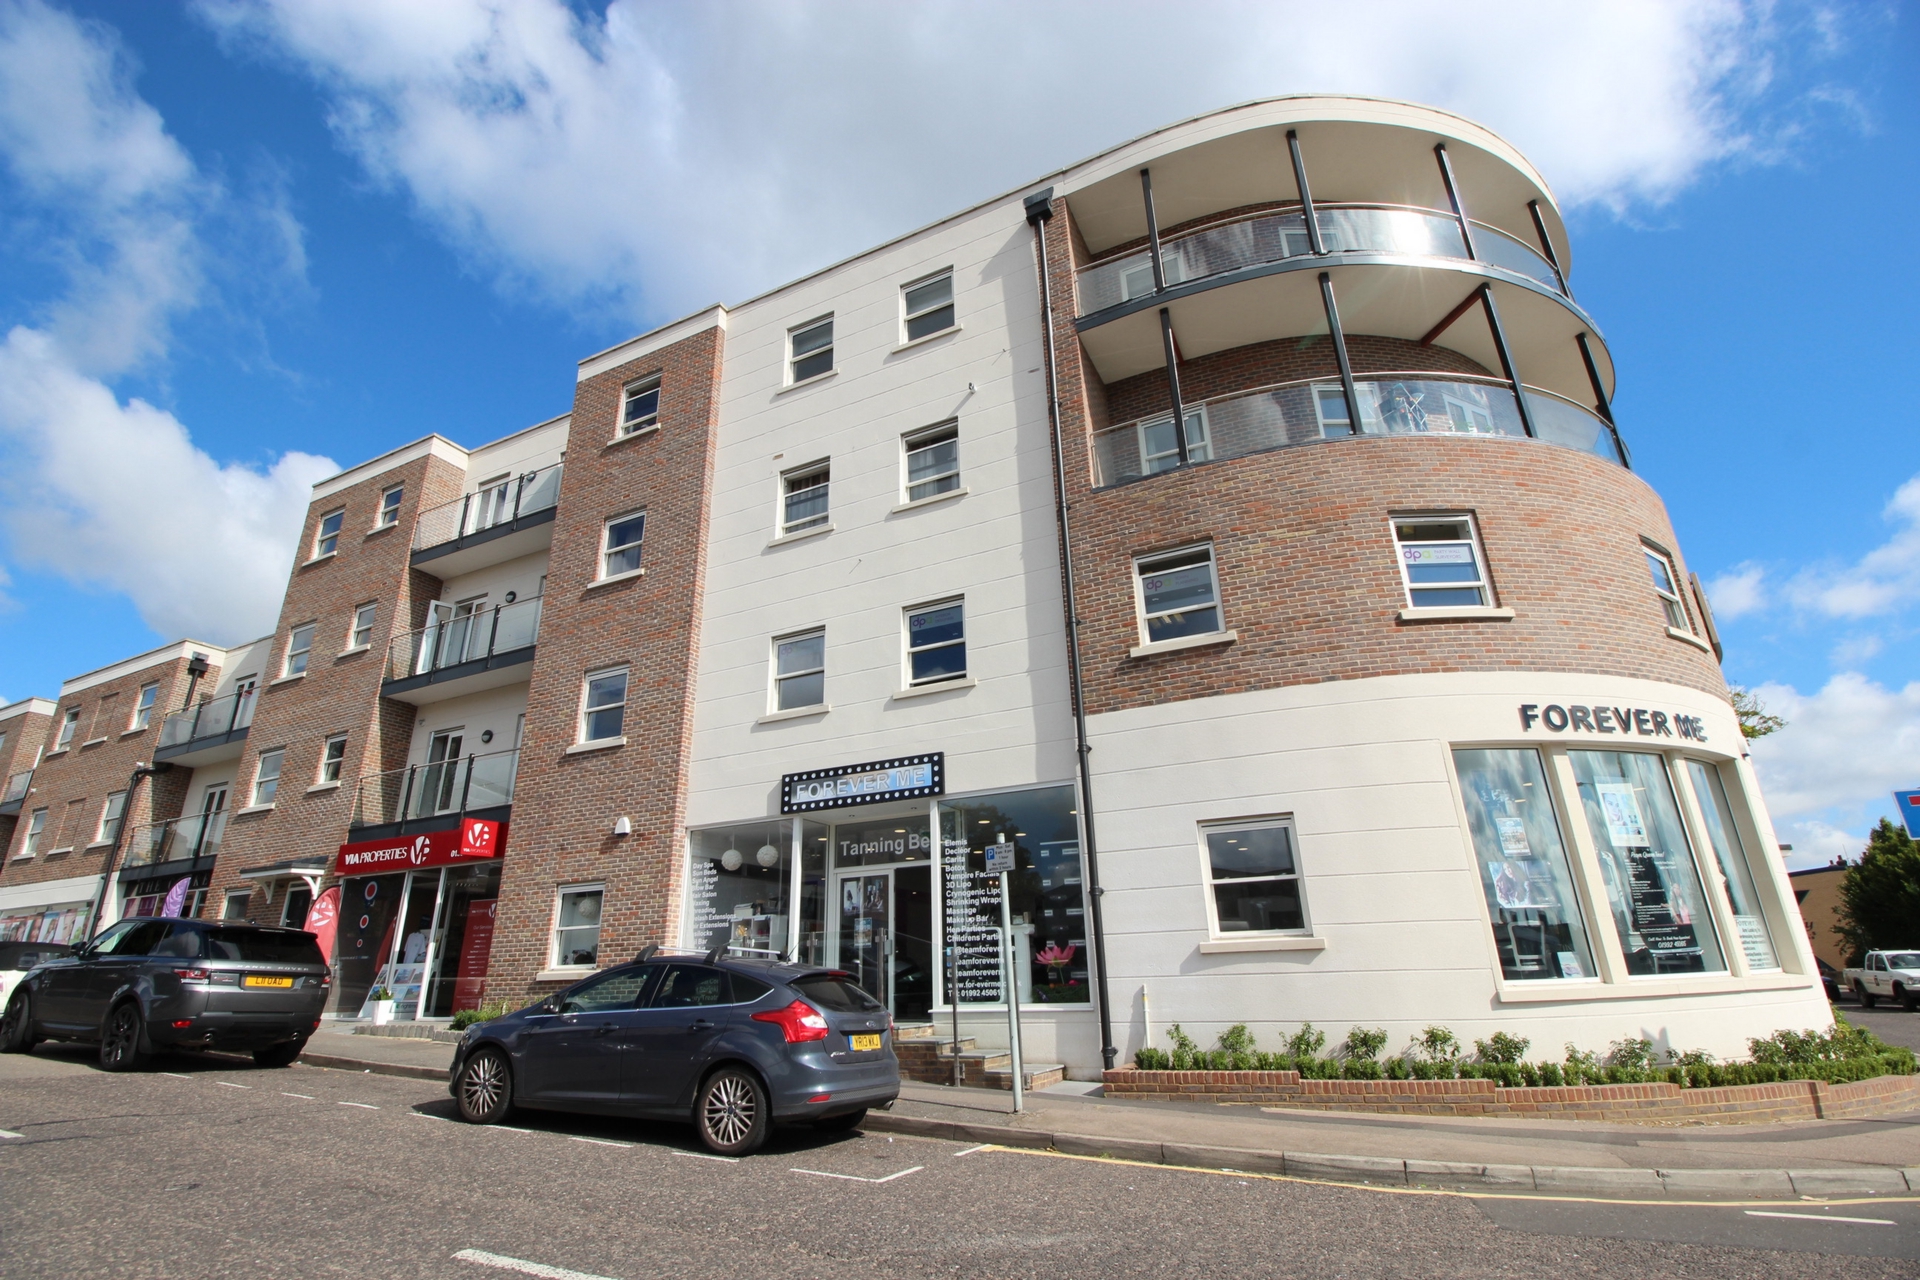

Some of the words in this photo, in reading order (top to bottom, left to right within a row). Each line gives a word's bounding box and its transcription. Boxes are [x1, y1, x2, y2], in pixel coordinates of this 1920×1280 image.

[1404, 548, 1432, 562] dpa
[1146, 577, 1173, 591] dpa
[1518, 704, 1672, 738] FOREVER
[1673, 713, 1708, 742] ME
[796, 773, 890, 800] FOREVER
[896, 767, 926, 788] ME
[840, 837, 905, 857] Tanning
[944, 839, 968, 847] Elemis
[345, 853, 360, 865] VIA
[359, 846, 408, 864] PROPERTIES
[987, 849, 994, 859] P
[945, 856, 966, 864] Carita
[703, 876, 719, 884] Angel
[945, 873, 974, 881] Vampire
[945, 881, 955, 889] 3D
[956, 881, 972, 889] Lipo
[946, 898, 979, 906] Shrinking
[946, 907, 977, 915] Massage
[709, 913, 736, 921] Extensions
[946, 916, 964, 924] Make
[699, 921, 729, 929] Extensions
[946, 934, 980, 942] Childrens
[961, 989, 980, 997] 01992
